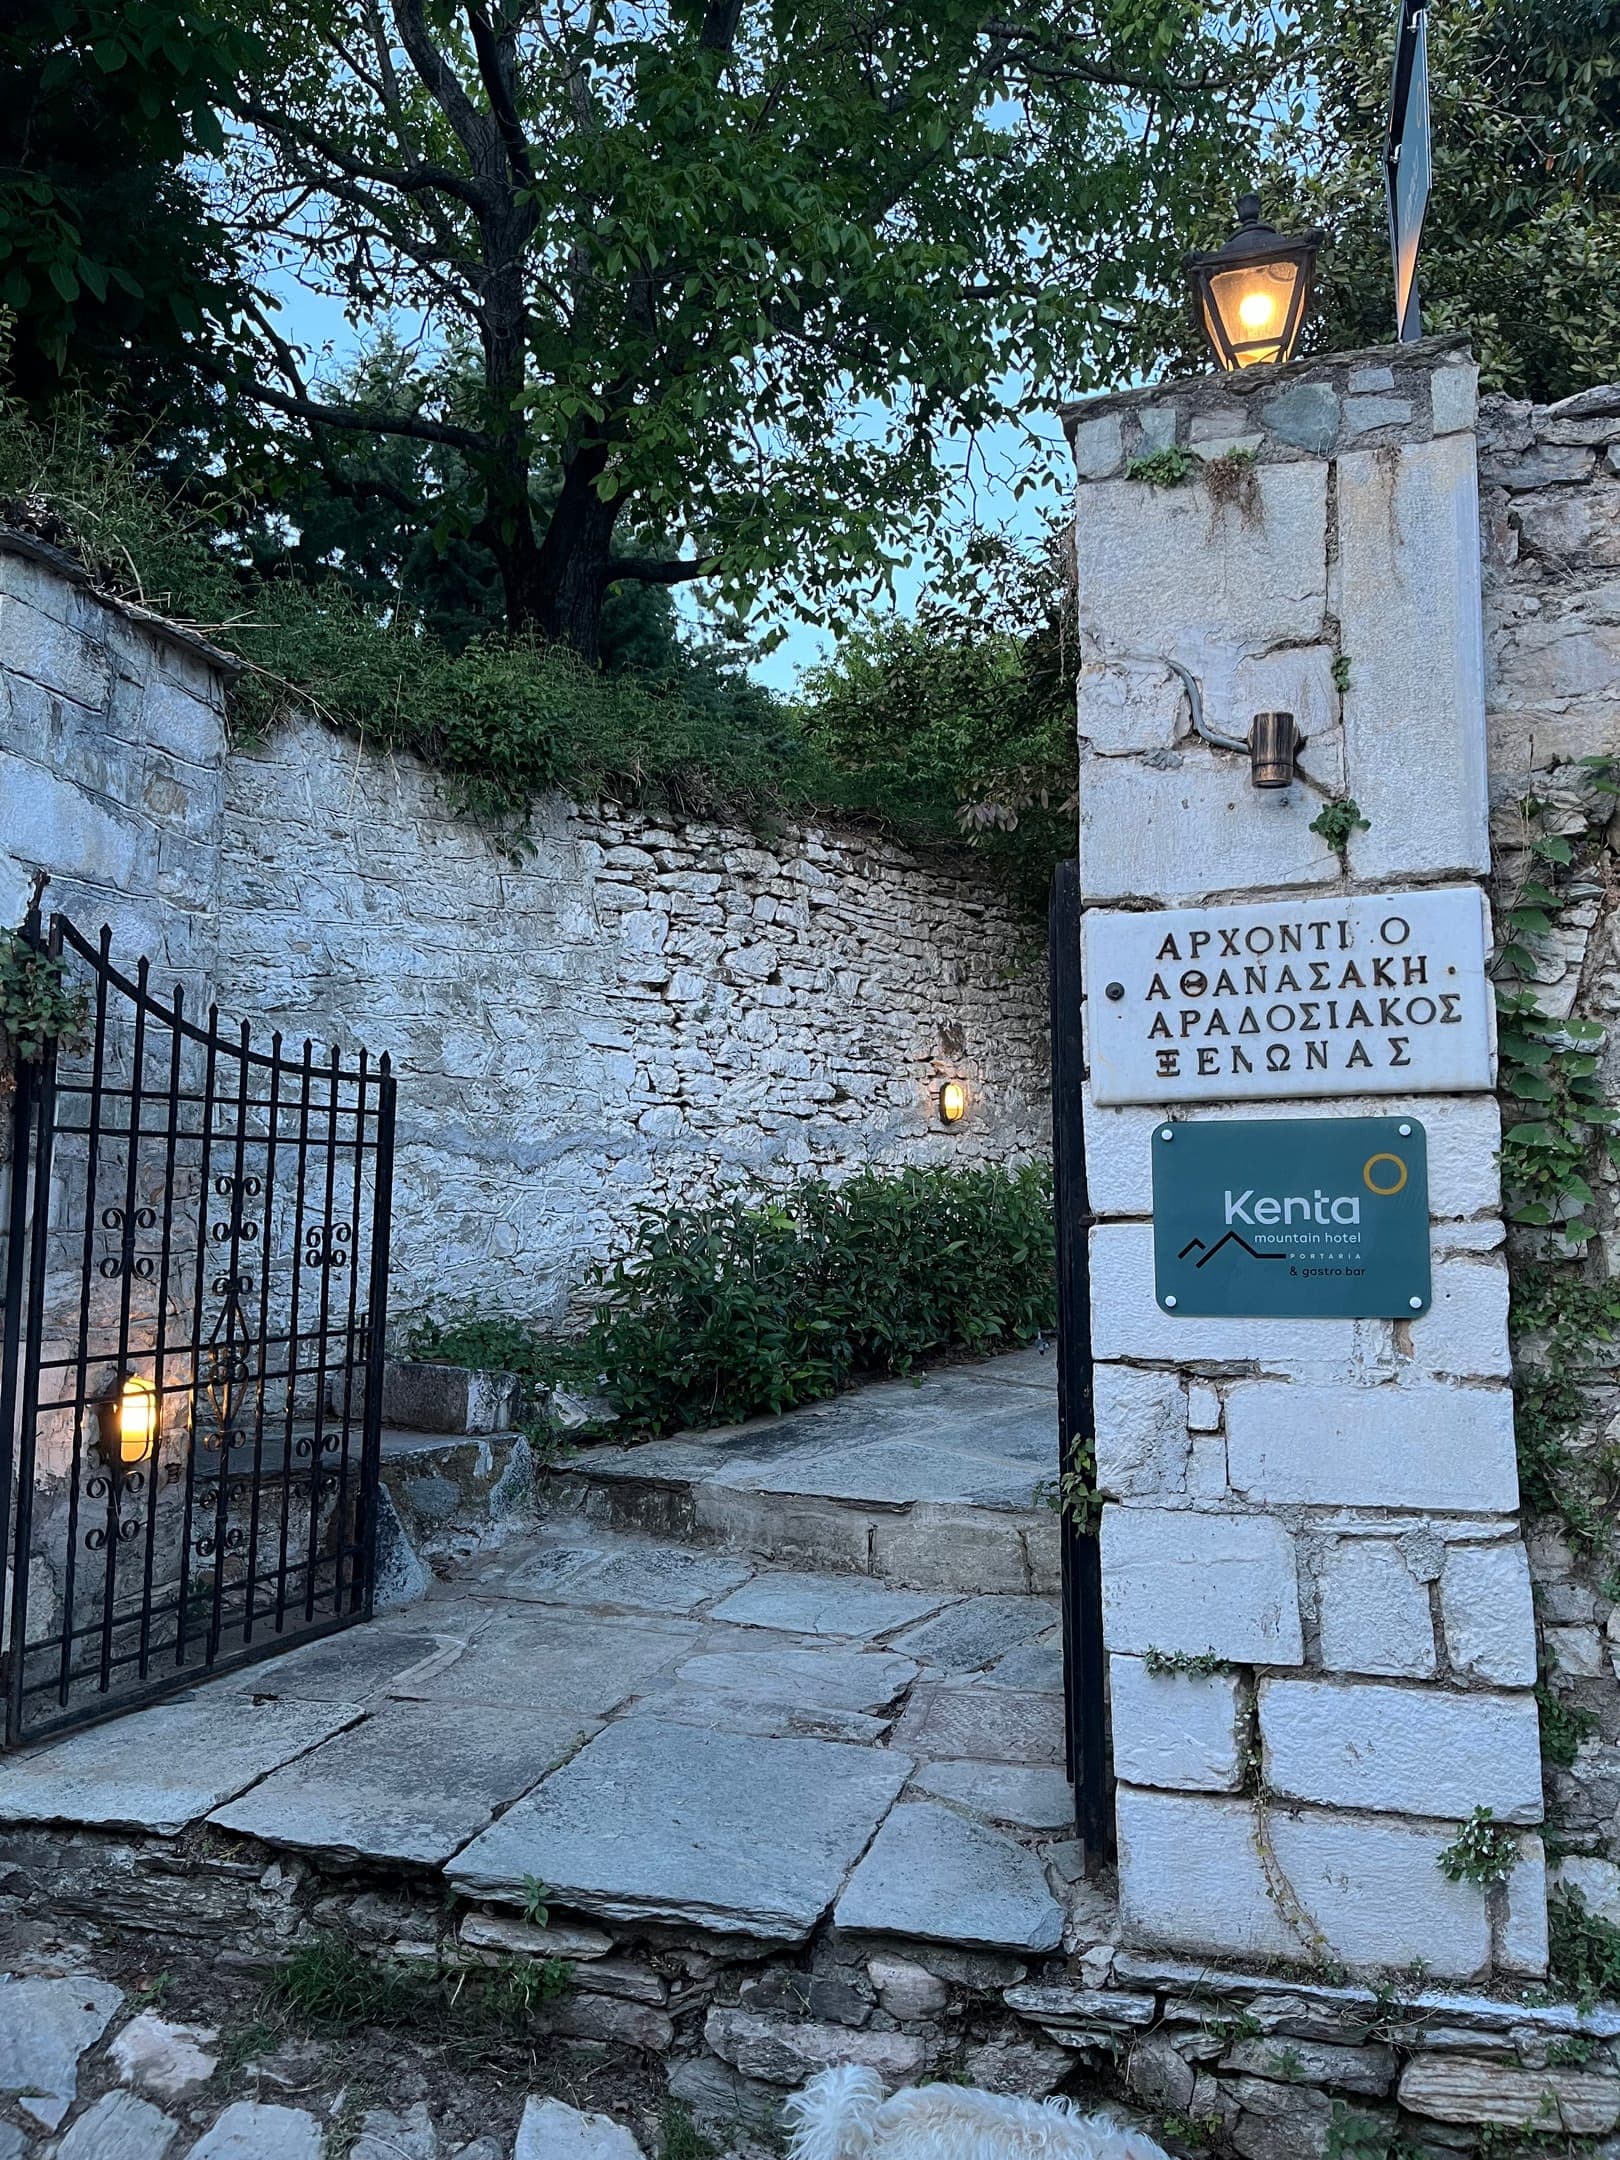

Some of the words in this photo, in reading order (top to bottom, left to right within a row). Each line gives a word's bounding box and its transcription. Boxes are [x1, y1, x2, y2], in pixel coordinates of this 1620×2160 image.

[1145, 955, 1429, 1001] ΑΘΑΝΑΣΑΚΗ
[1154, 1036, 1412, 1078] ΞΕΝΩΝΑΣ
[1223, 1189, 1361, 1226] Kenta
[1253, 1231, 1321, 1244] mountain
[1324, 1231, 1362, 1244] hotel
[1289, 1266, 1298, 1277] &
[1302, 1266, 1342, 1278] gastro
[1345, 1266, 1367, 1276] bar
